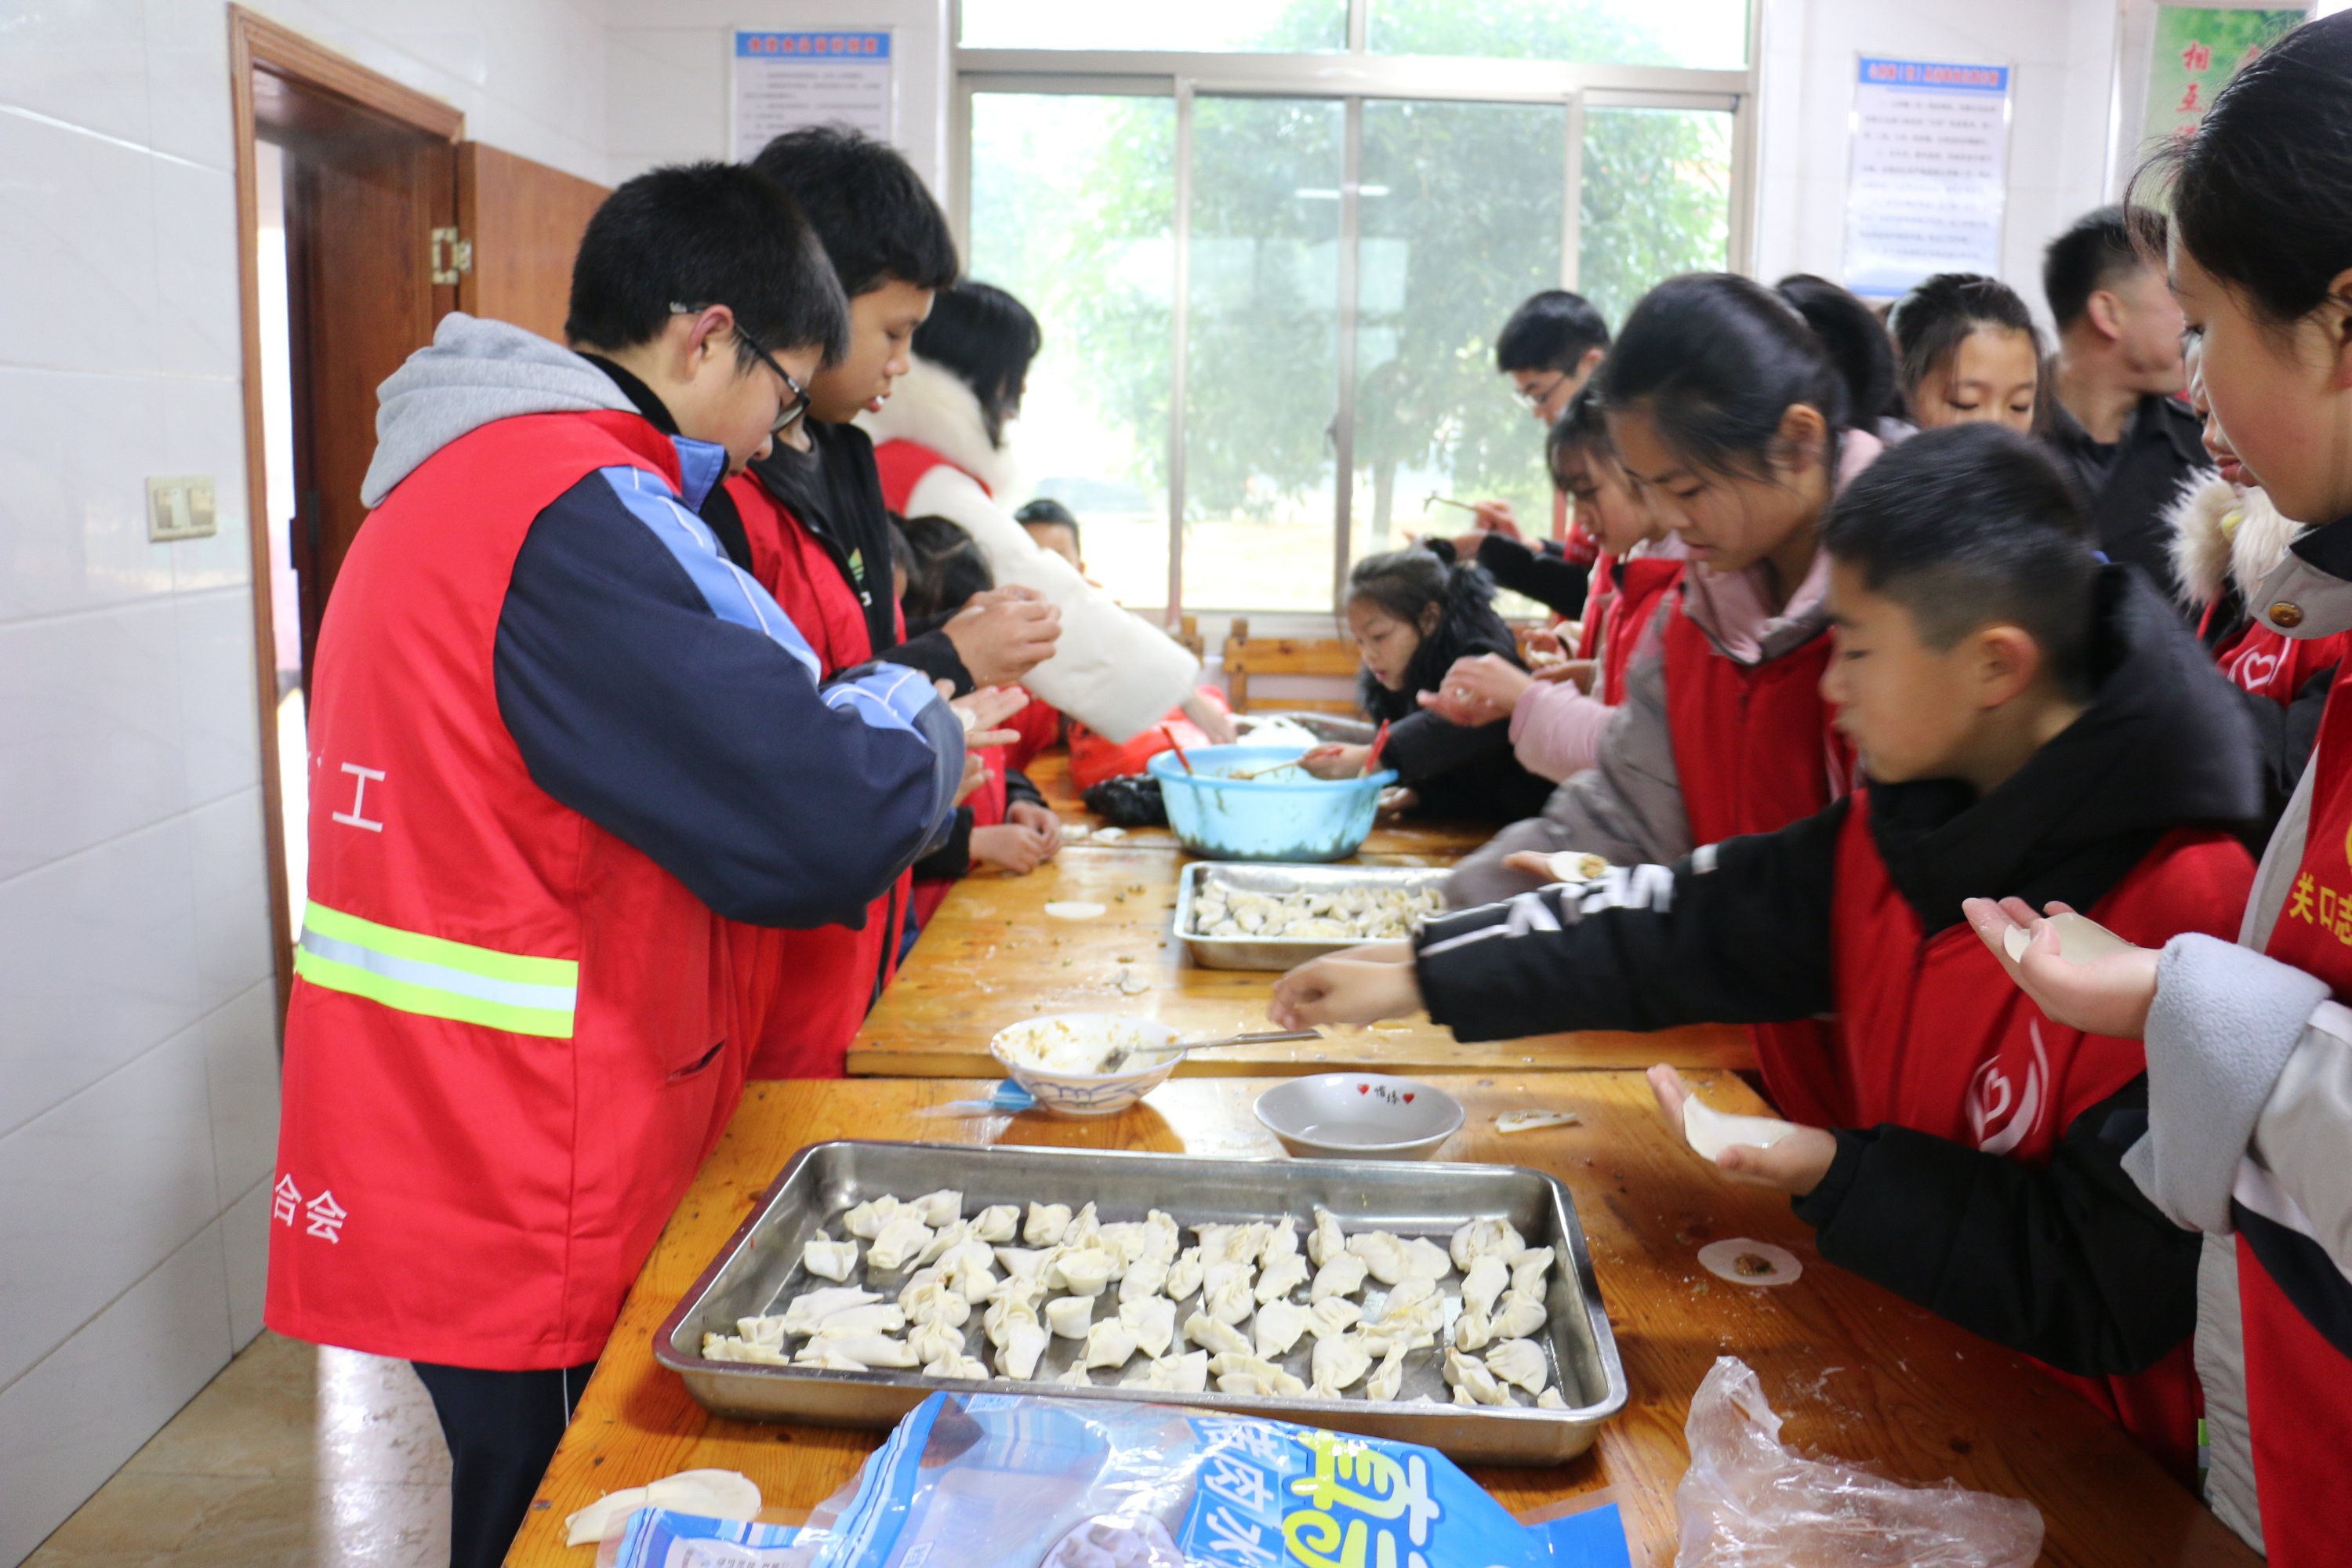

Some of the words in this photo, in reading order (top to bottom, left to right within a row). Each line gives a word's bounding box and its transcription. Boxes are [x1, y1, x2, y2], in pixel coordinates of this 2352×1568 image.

[316, 750, 386, 833] 工
[274, 1173, 347, 1244] 合会
[1198, 1419, 1279, 1568] 猪肉水
